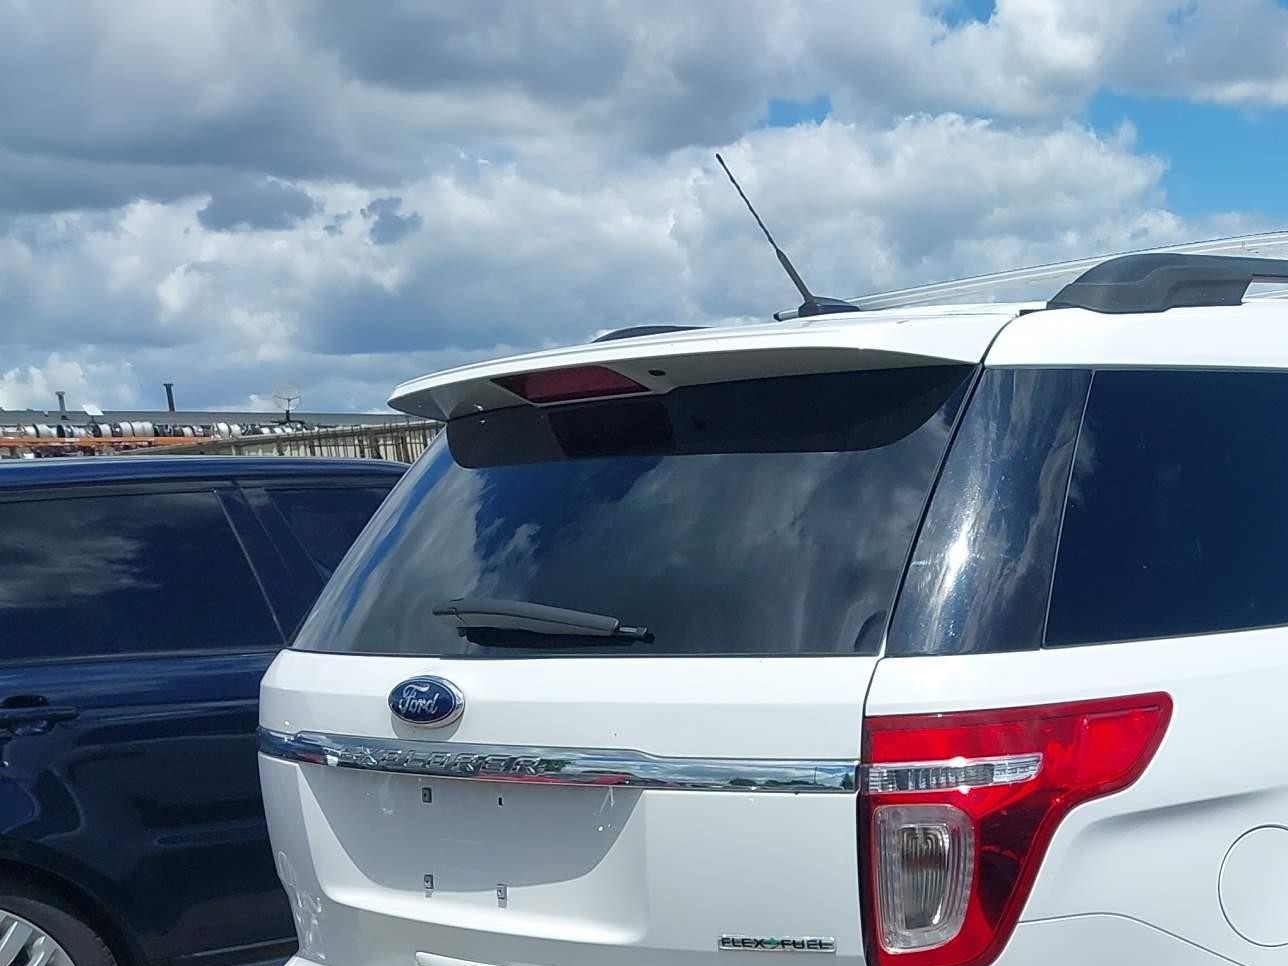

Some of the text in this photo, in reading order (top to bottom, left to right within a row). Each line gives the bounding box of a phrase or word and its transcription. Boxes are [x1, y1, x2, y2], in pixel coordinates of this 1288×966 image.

[399, 682, 441, 715] Ford
[338, 746, 545, 776] EXPLORER
[720, 937, 835, 950] FLEX FUEL
